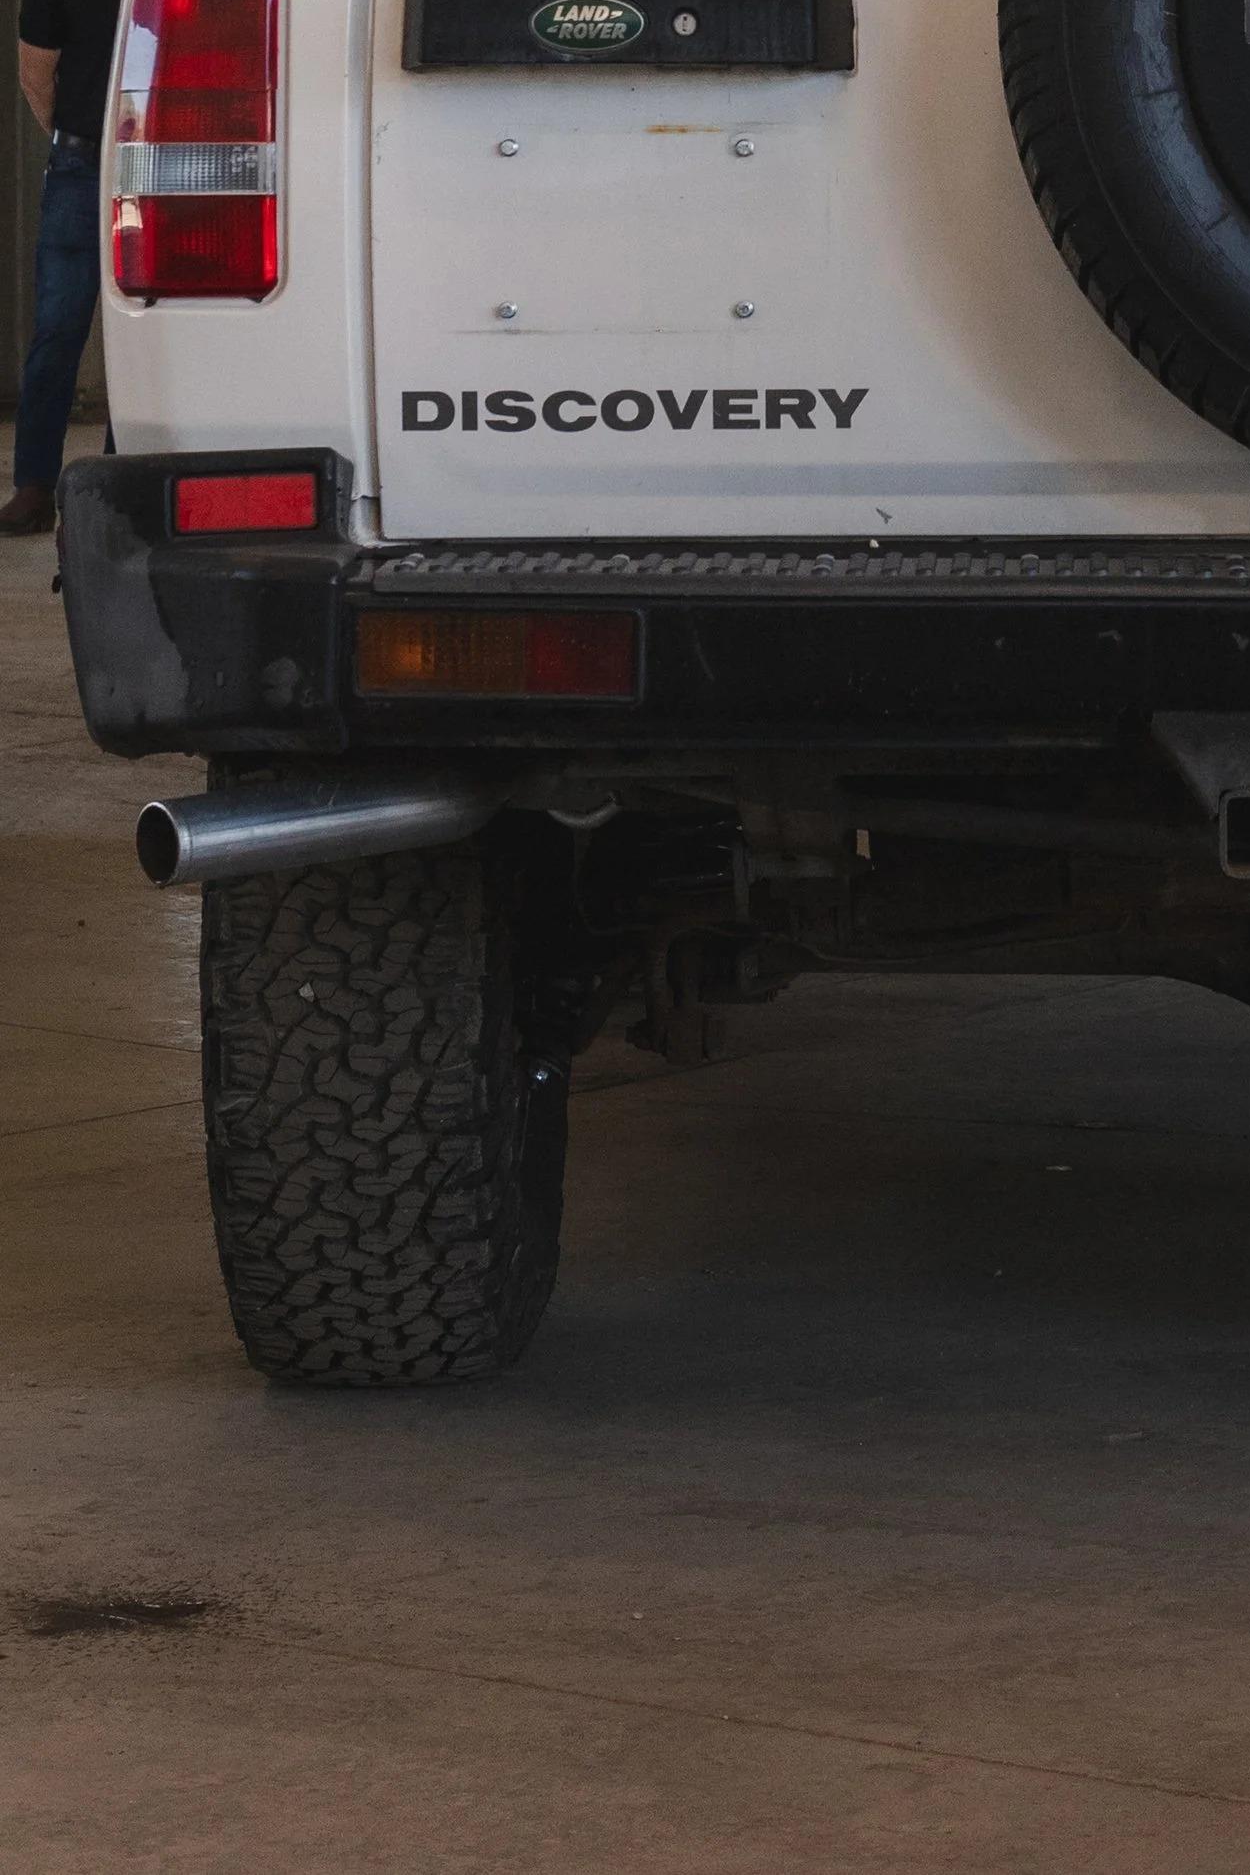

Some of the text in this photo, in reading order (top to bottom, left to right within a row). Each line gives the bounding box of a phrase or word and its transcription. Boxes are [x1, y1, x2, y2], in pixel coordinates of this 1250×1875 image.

[553, 5, 609, 21] LAND
[558, 23, 627, 39] ROVER
[401, 388, 869, 432] DISCOVERY
